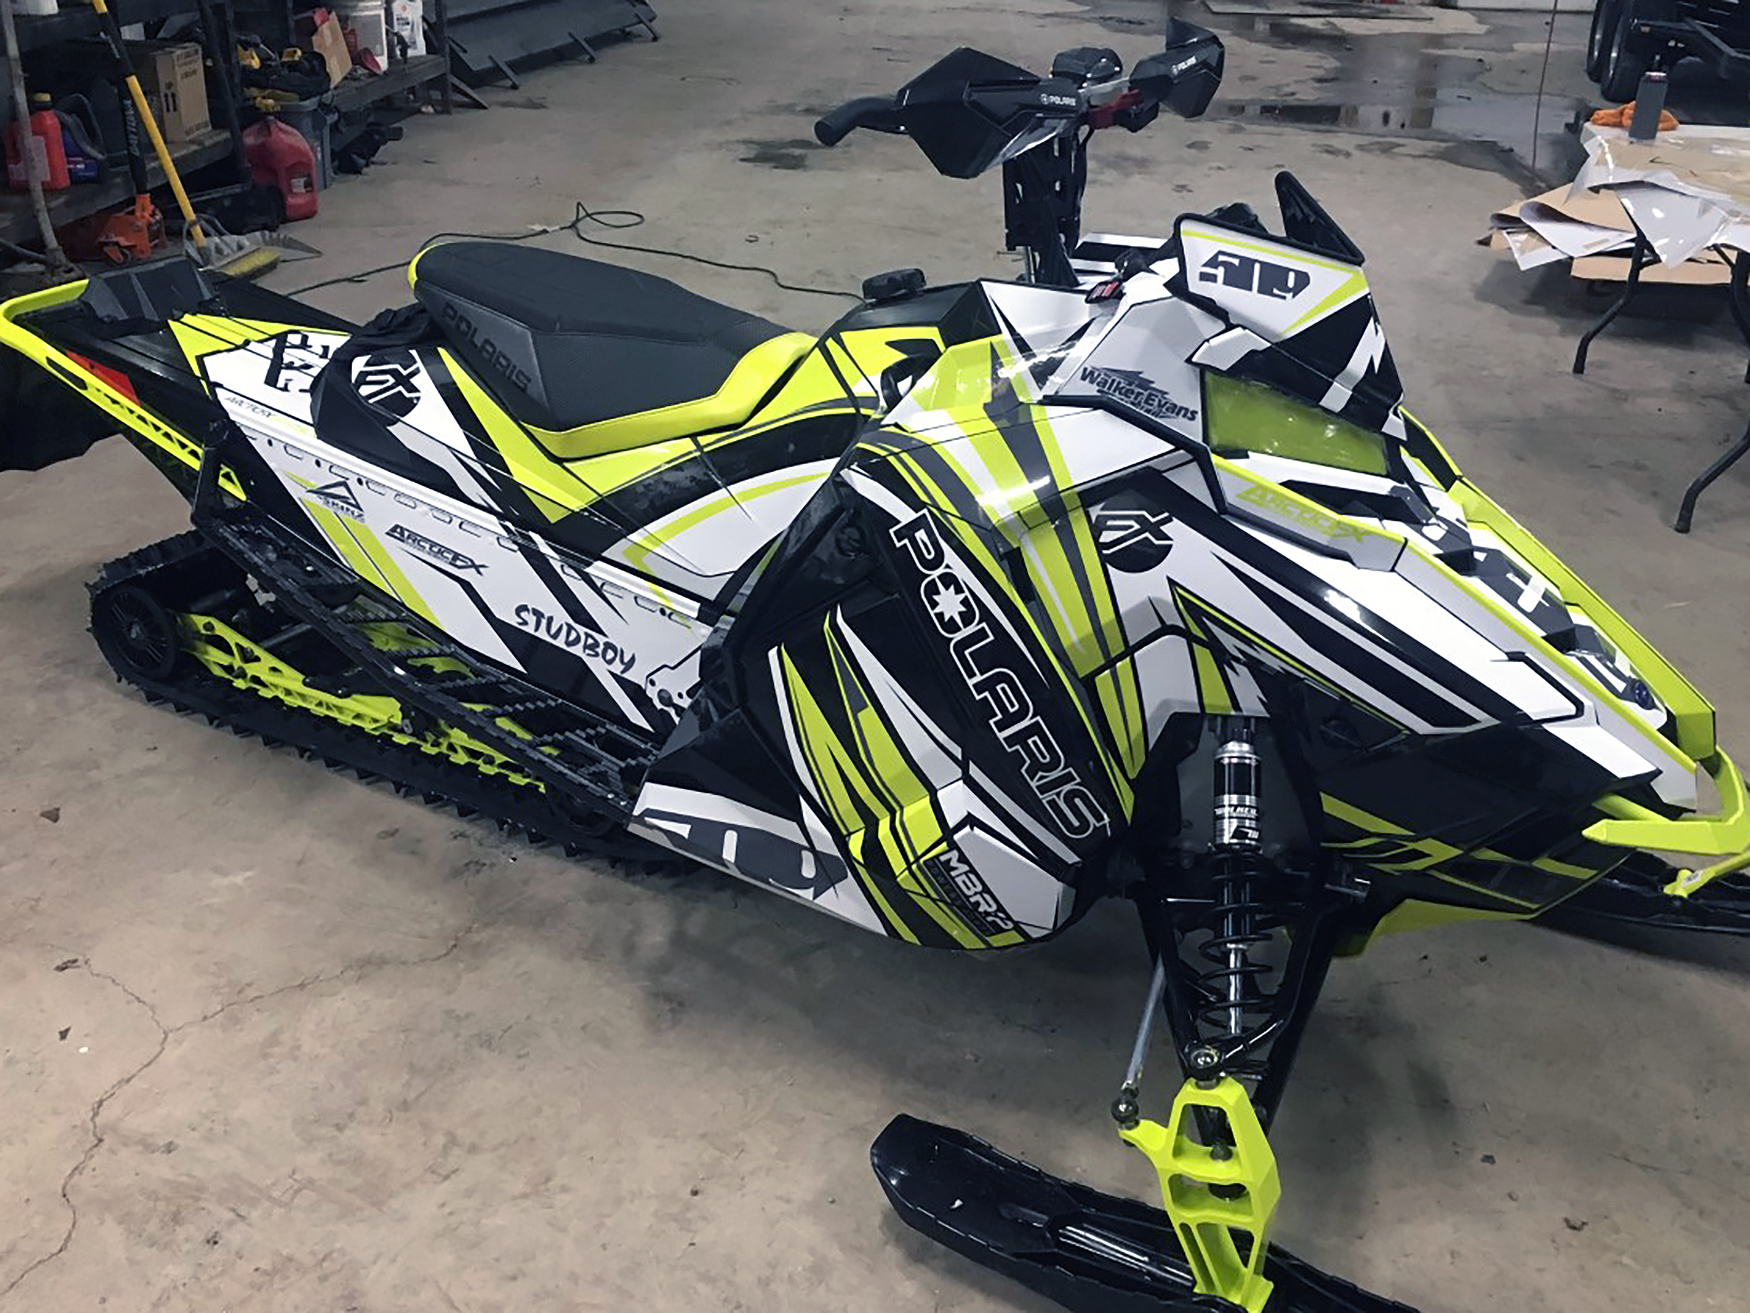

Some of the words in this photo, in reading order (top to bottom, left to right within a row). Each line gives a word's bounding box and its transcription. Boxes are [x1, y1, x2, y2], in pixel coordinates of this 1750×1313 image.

[443, 300, 532, 393] POLARIS
[514, 604, 636, 674] STUDBOY
[889, 508, 1108, 838] POLARIS
